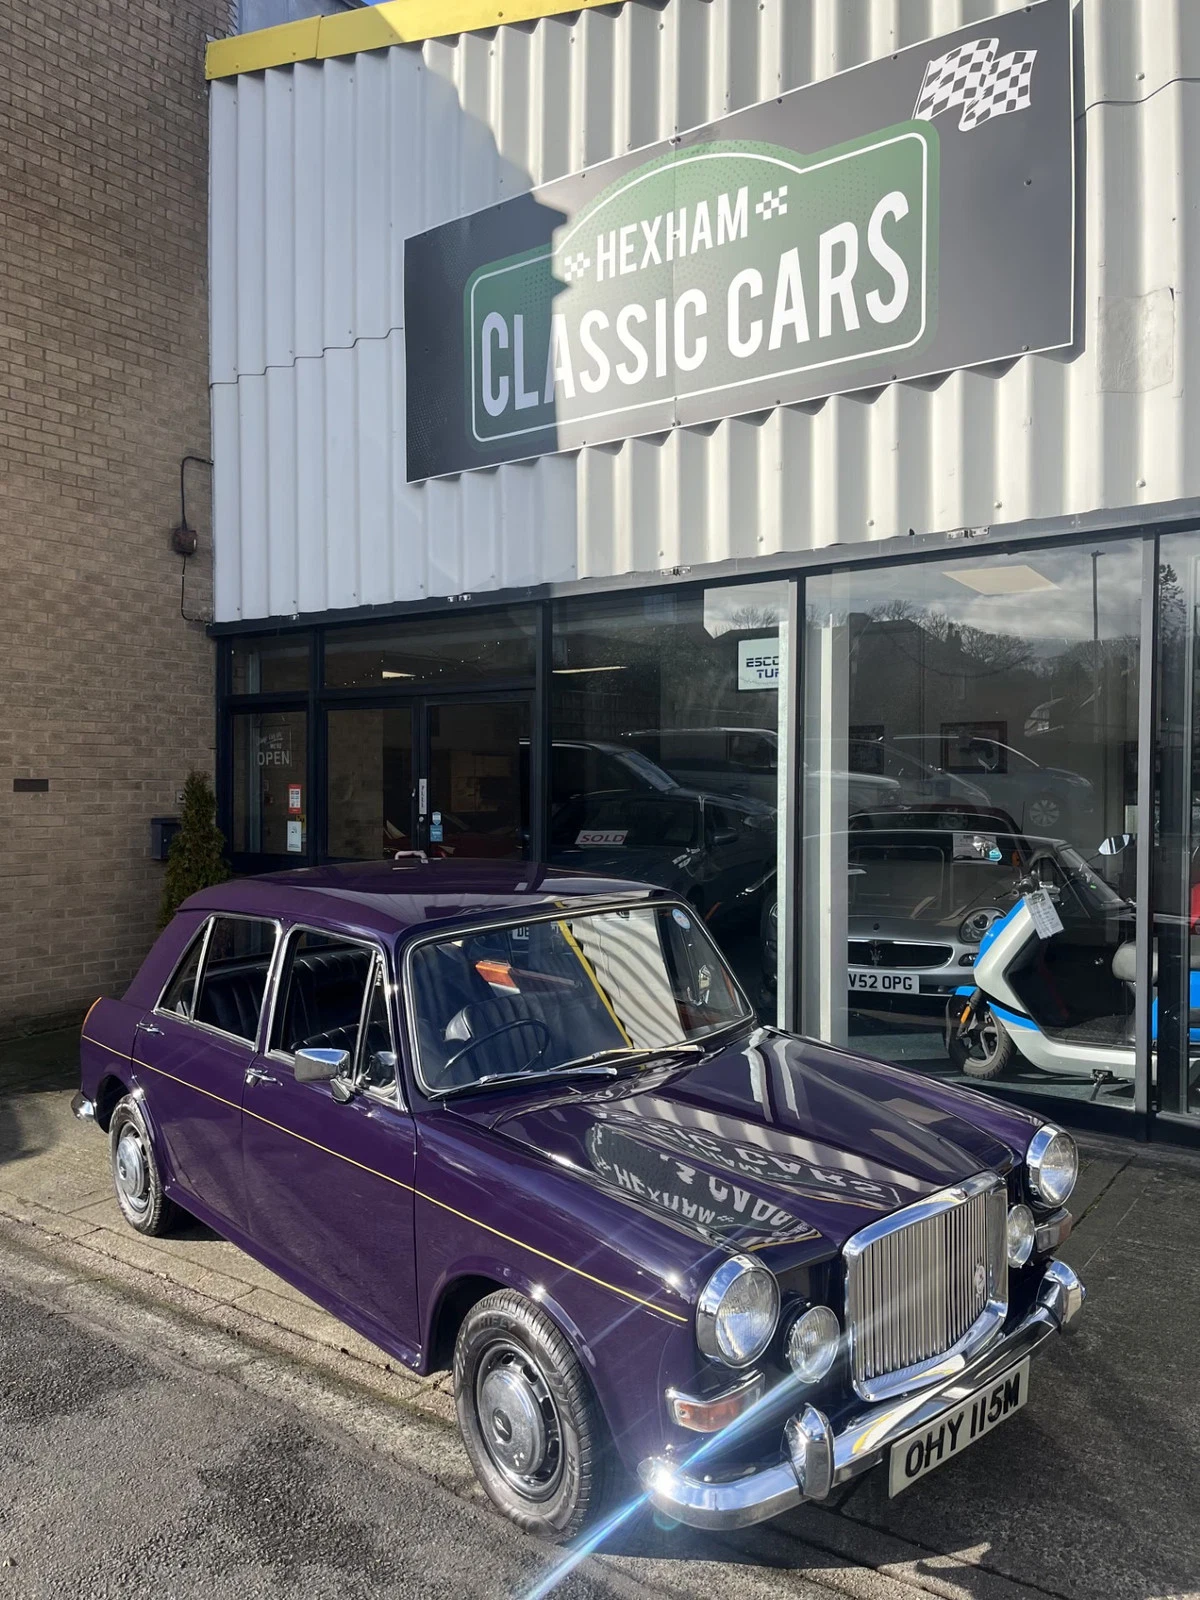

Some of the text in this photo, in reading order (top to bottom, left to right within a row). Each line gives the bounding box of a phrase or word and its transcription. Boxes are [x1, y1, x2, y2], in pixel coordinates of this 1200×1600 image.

[596, 186, 748, 282] HEXHAM
[482, 191, 909, 417] CLASSIC CARS
[257, 750, 290, 766] OPEN
[580, 834, 625, 843] SOLD
[848, 973, 913, 991] V52 OPG
[905, 1372, 1020, 1478] OHY 115M
